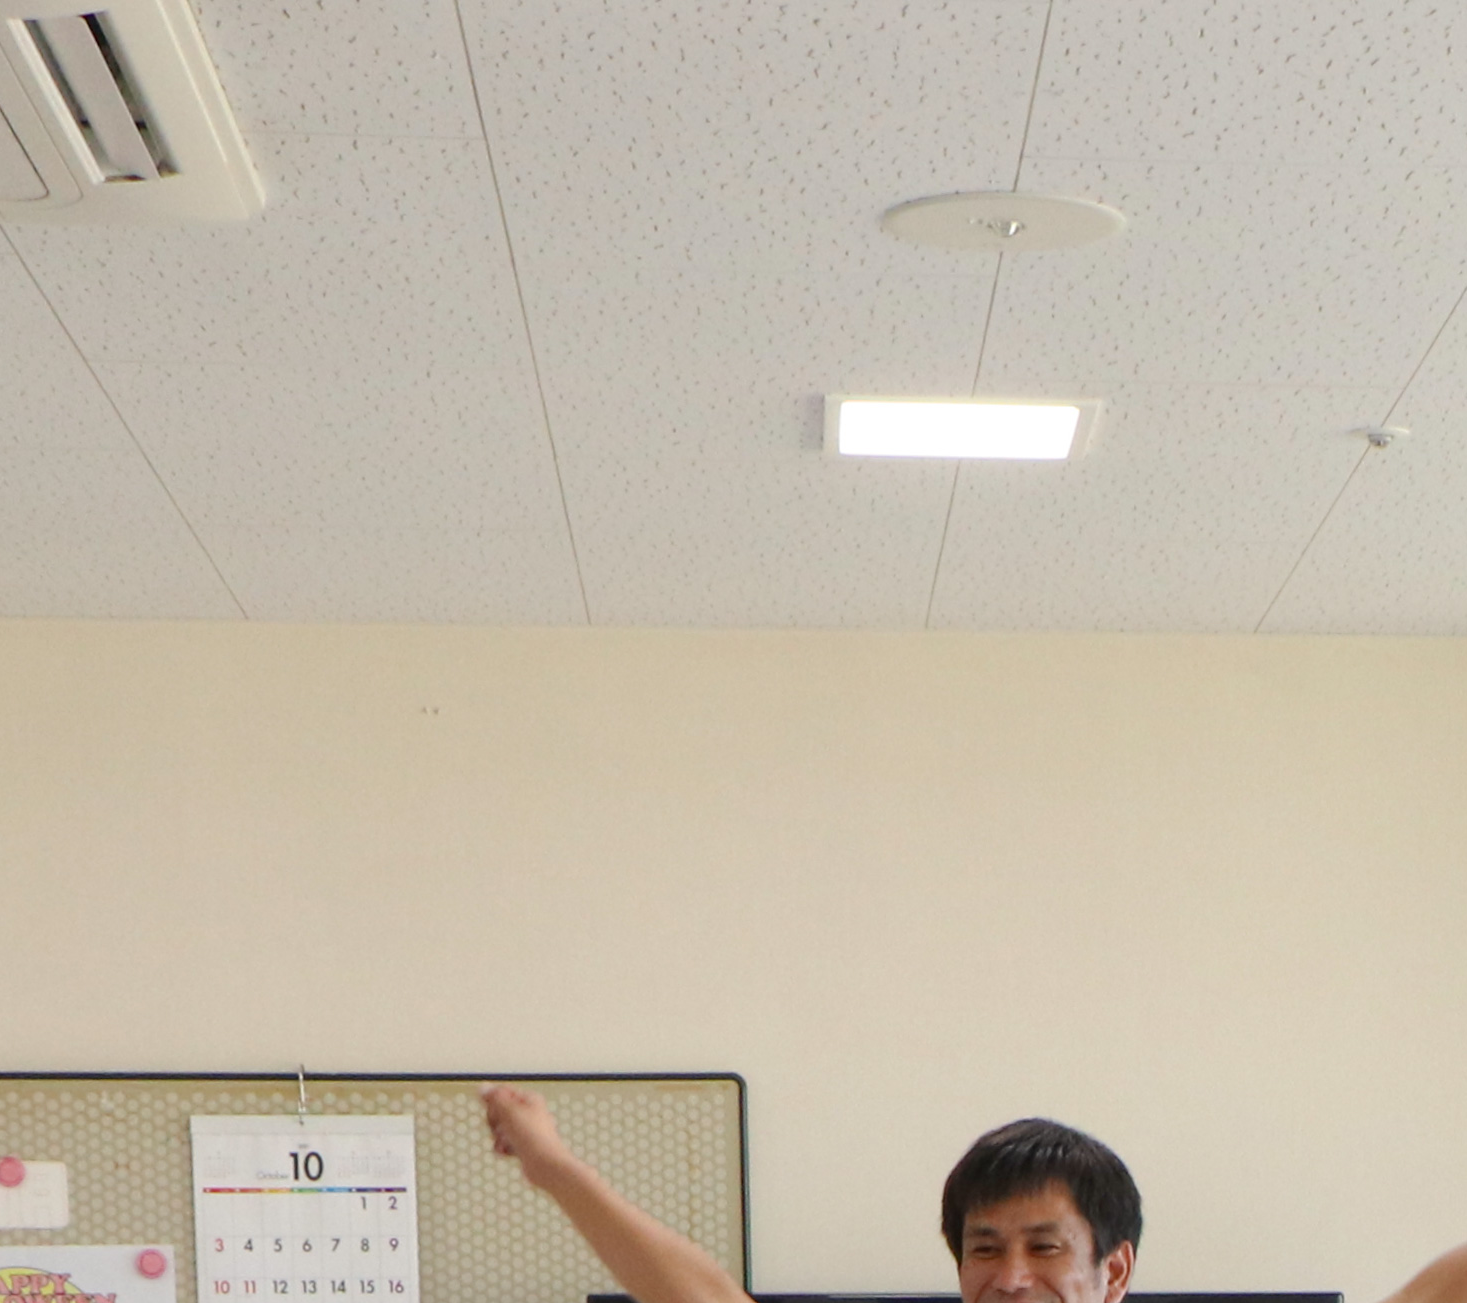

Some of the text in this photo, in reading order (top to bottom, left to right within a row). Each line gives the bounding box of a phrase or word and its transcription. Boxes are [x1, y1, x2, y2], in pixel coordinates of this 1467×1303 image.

[289, 1151, 324, 1181] 10
[214, 1279, 405, 1295] 10 11 12 13 14 15 16
